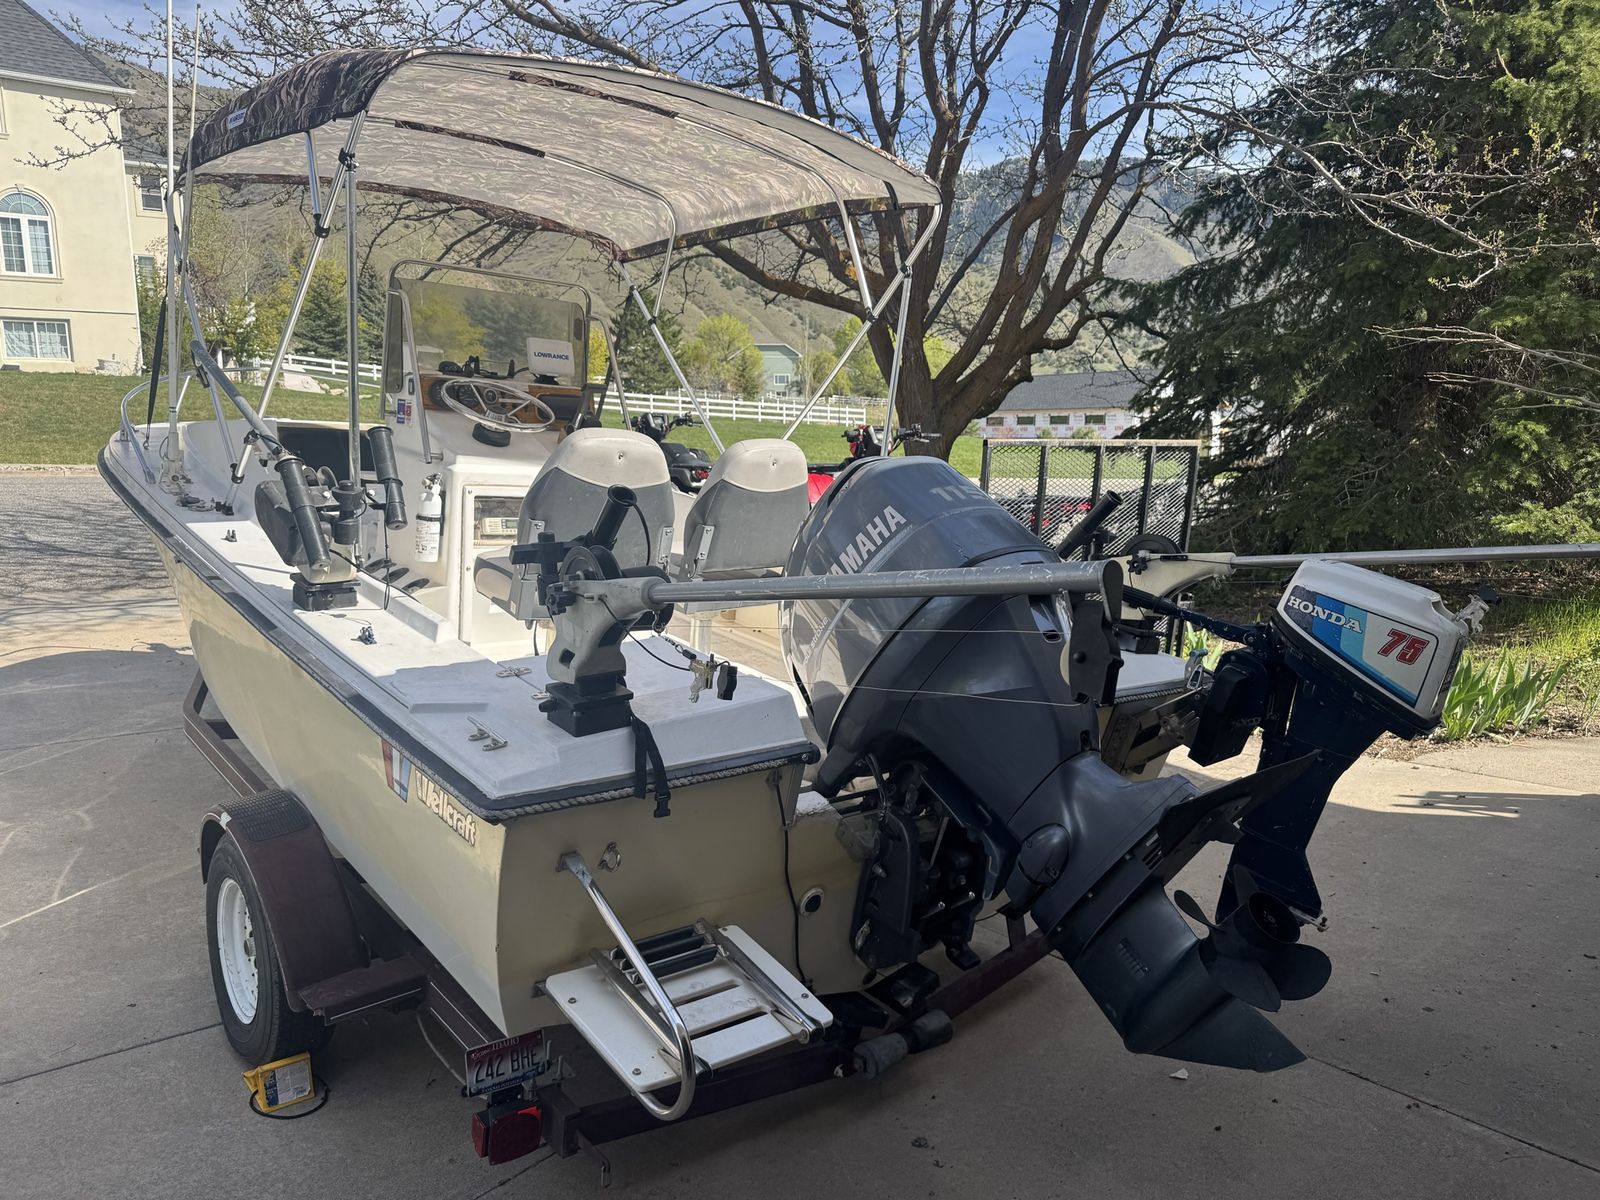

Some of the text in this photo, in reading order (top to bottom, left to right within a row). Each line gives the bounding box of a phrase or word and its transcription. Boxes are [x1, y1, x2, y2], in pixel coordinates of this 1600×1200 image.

[533, 351, 569, 361] LOWRANCE
[830, 505, 907, 576] AMAHA
[1287, 595, 1363, 634] HONDA
[1377, 628, 1430, 666] 75
[414, 767, 477, 848] Wellcraft
